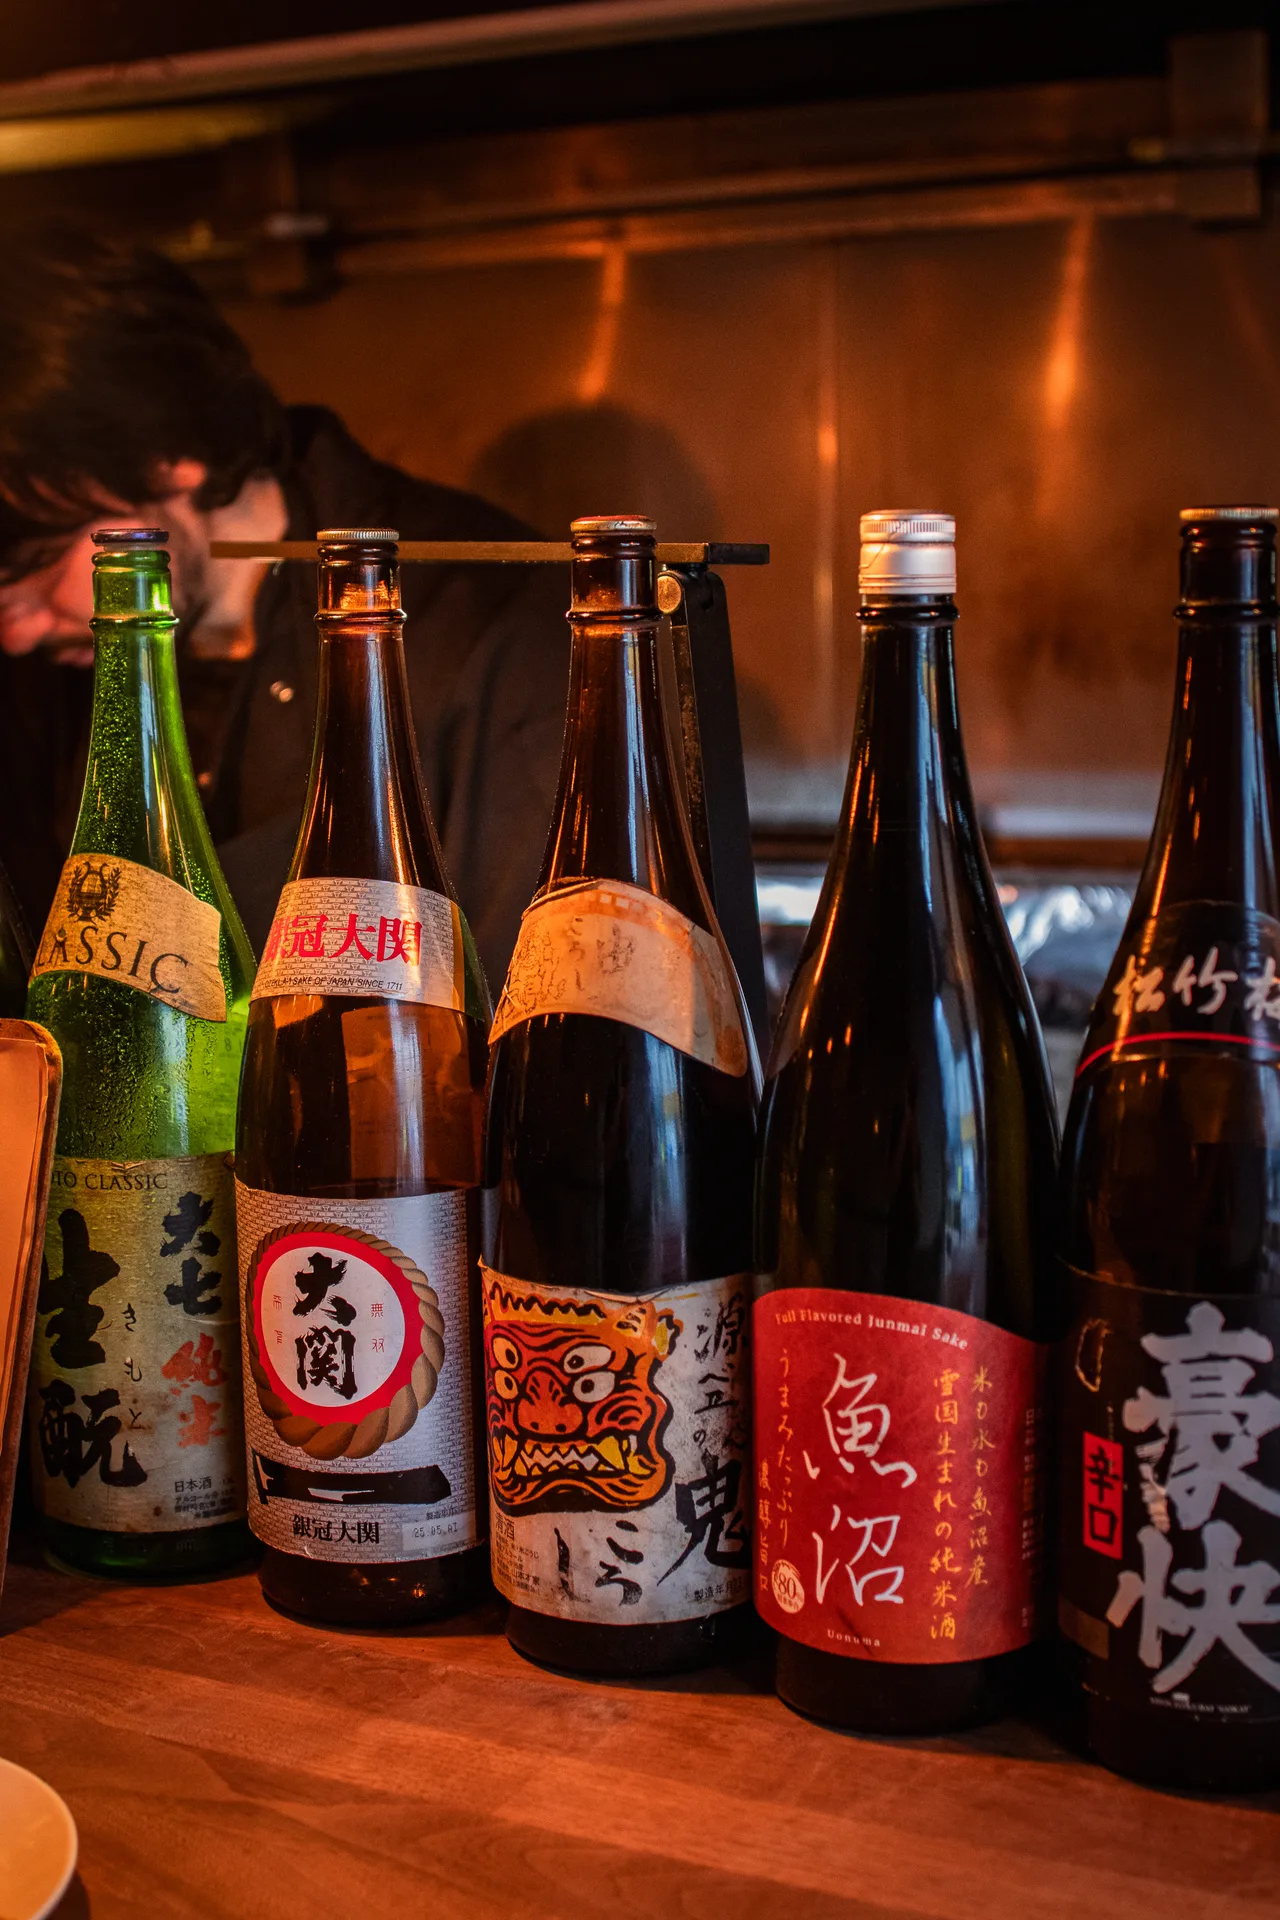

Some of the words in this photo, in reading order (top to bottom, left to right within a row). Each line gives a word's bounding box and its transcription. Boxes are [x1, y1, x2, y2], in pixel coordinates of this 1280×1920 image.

[314, 977, 326, 986] OF
[327, 977, 355, 986] JAPAN
[357, 979, 384, 989] SINCE
[387, 981, 403, 991] 1711
[85, 1173, 168, 1191] CLASSIC
[293, 1252, 357, 1400] 大関
[775, 1310, 796, 1324] Full
[801, 1309, 862, 1325] Flavored
[868, 1314, 927, 1337] Junmai
[932, 1327, 968, 1350] Sake
[174, 1476, 212, 1493] 日本酒
[929, 1368, 962, 1640] 雪国生まれの純米酒
[292, 1514, 380, 1544] 銀冠大関
[778, 1572, 797, 1599] 80
[826, 1629, 881, 1648] Uonuma
